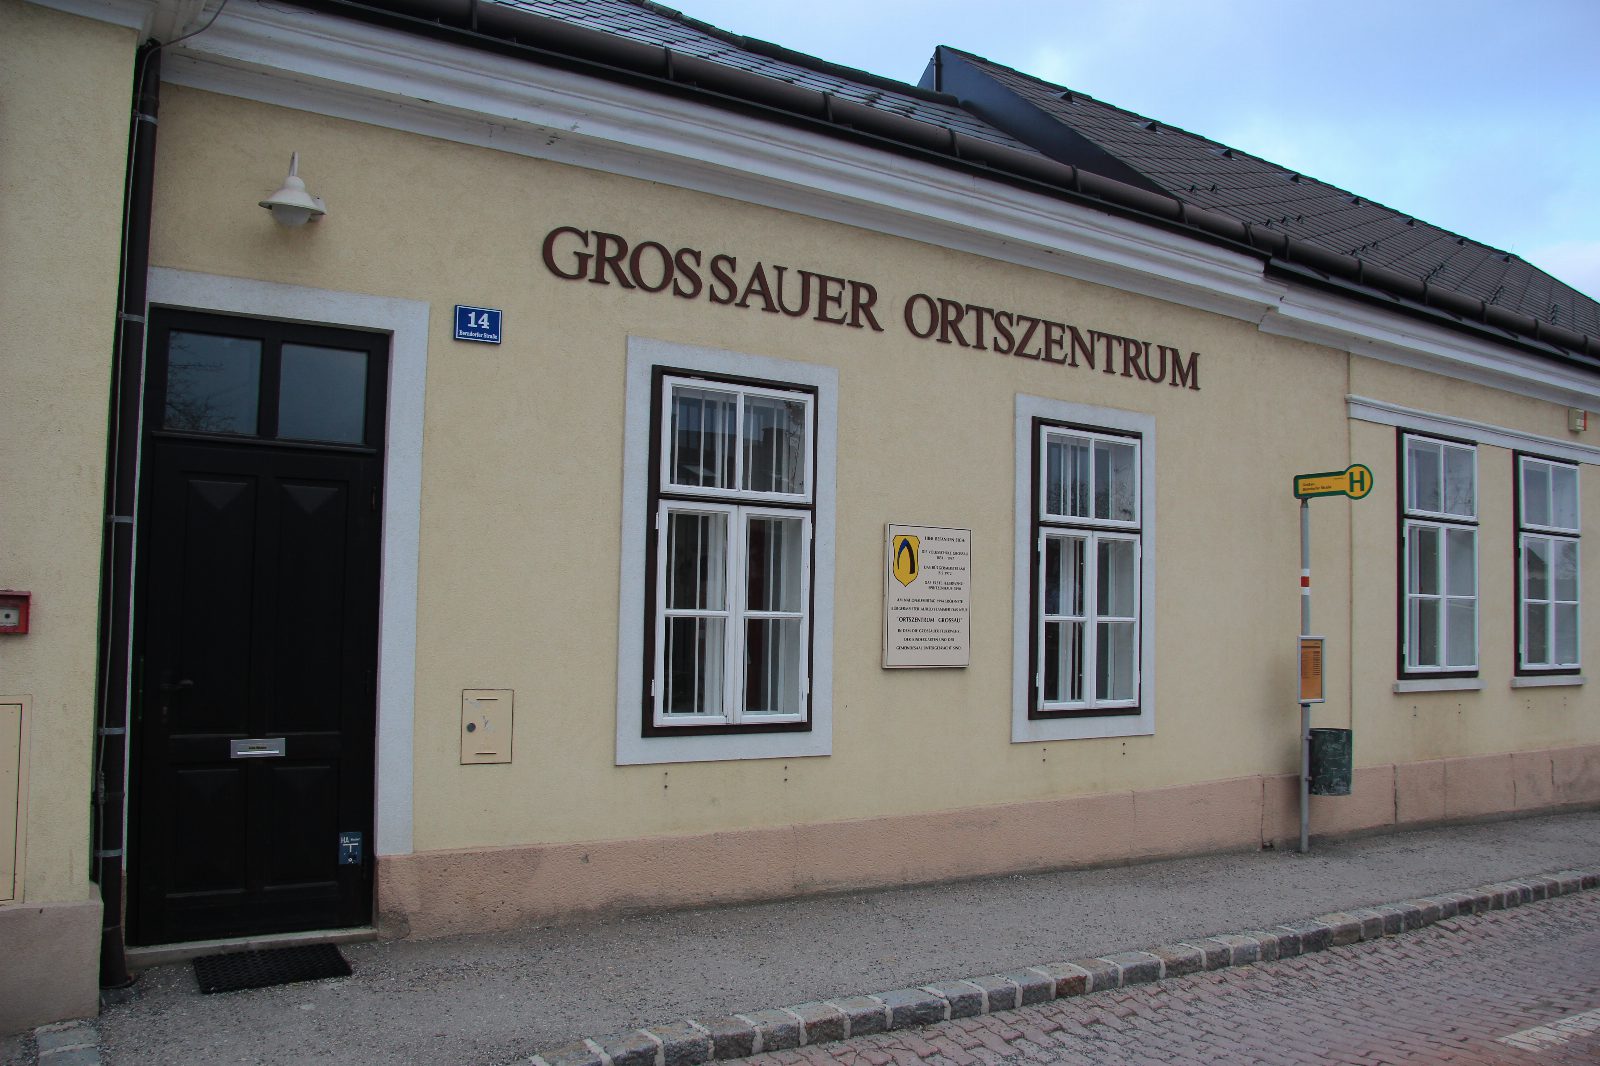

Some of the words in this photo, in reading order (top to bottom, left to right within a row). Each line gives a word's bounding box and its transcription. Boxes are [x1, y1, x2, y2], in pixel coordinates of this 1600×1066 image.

[542, 226, 884, 332] GROSSAUER
[904, 293, 1200, 390] ORTSZENTRUM
[467, 311, 489, 329] 14
[1349, 470, 1365, 492] H
